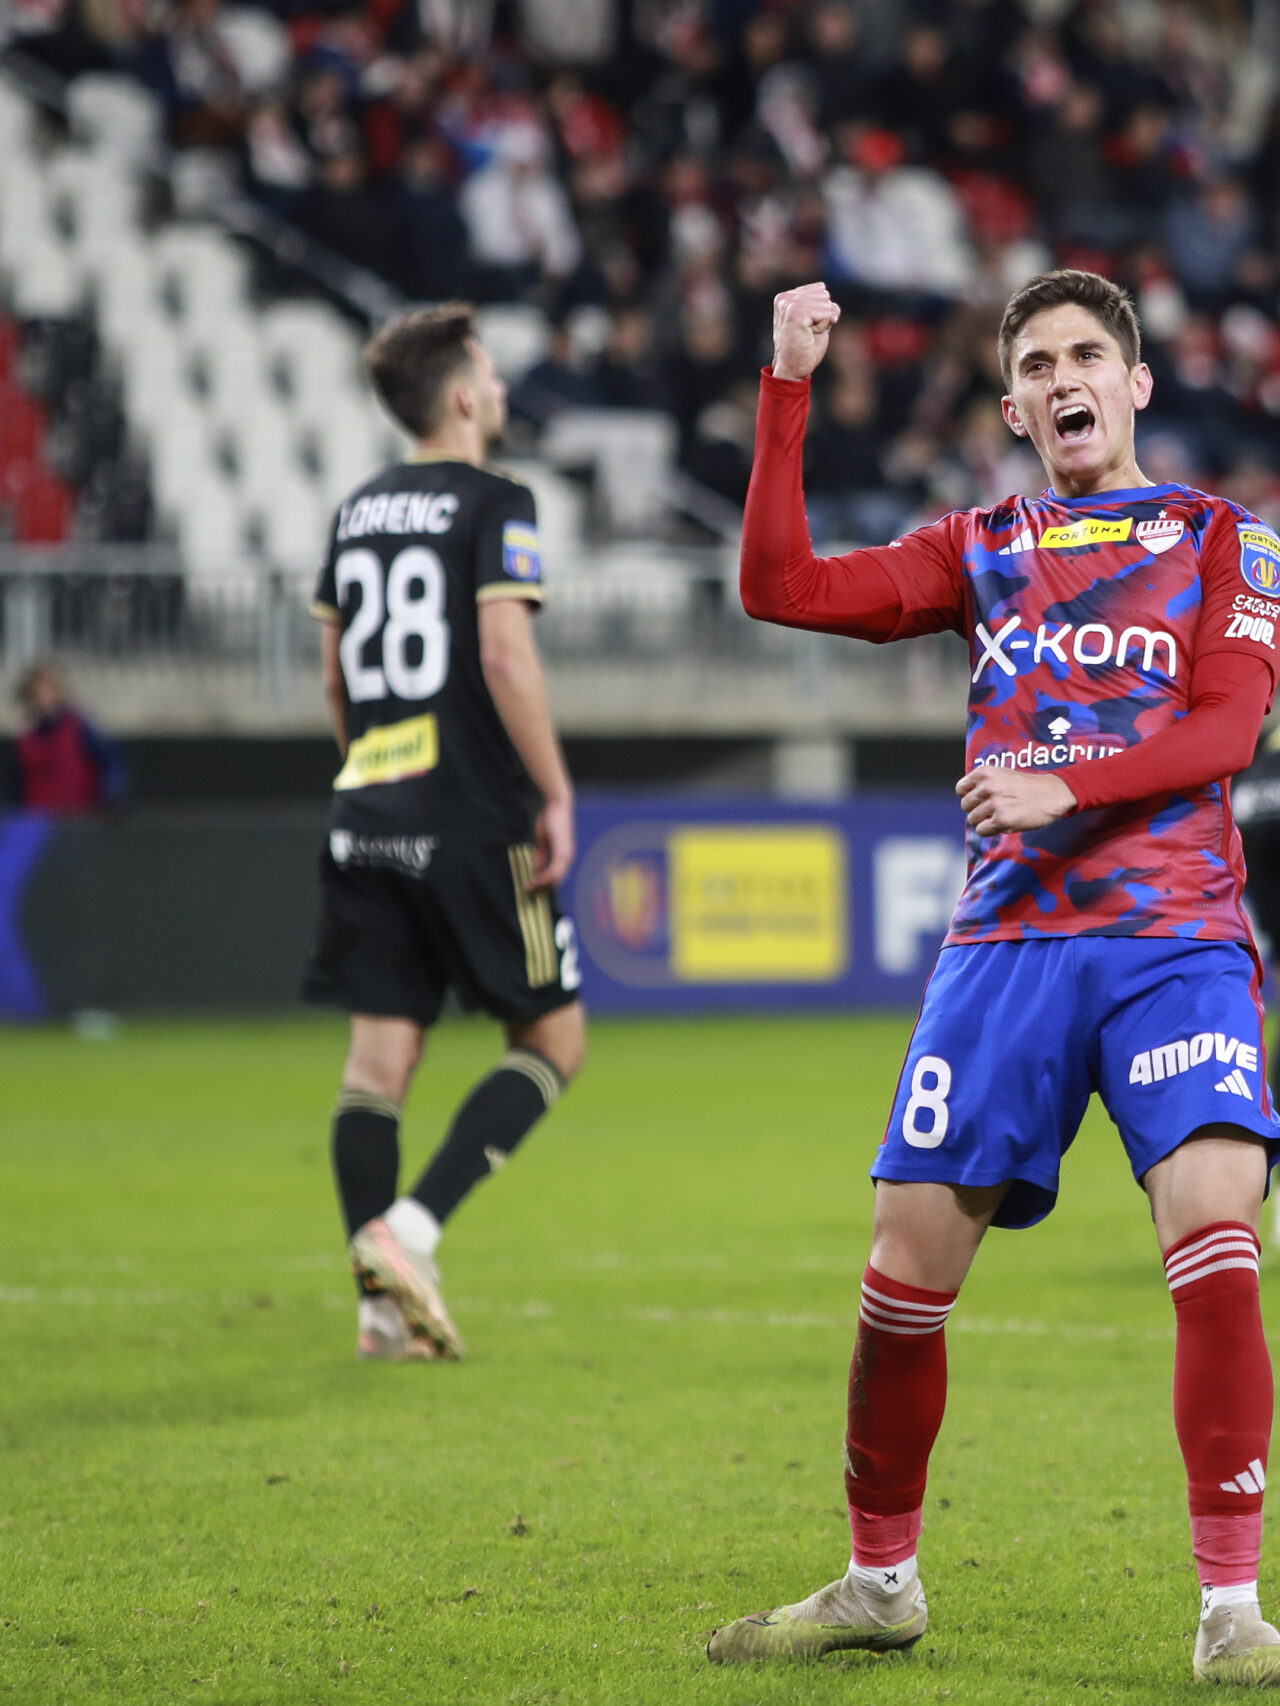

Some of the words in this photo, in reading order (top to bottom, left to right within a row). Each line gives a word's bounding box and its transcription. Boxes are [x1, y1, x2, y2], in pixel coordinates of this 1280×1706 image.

[336, 491, 459, 541] LORENC
[1049, 526, 1121, 541] FORTUNA
[1244, 533, 1280, 553] FORTUNA
[335, 544, 449, 702] 28
[1129, 1032, 1257, 1086] 4MOVE
[902, 1055, 952, 1149] 8
